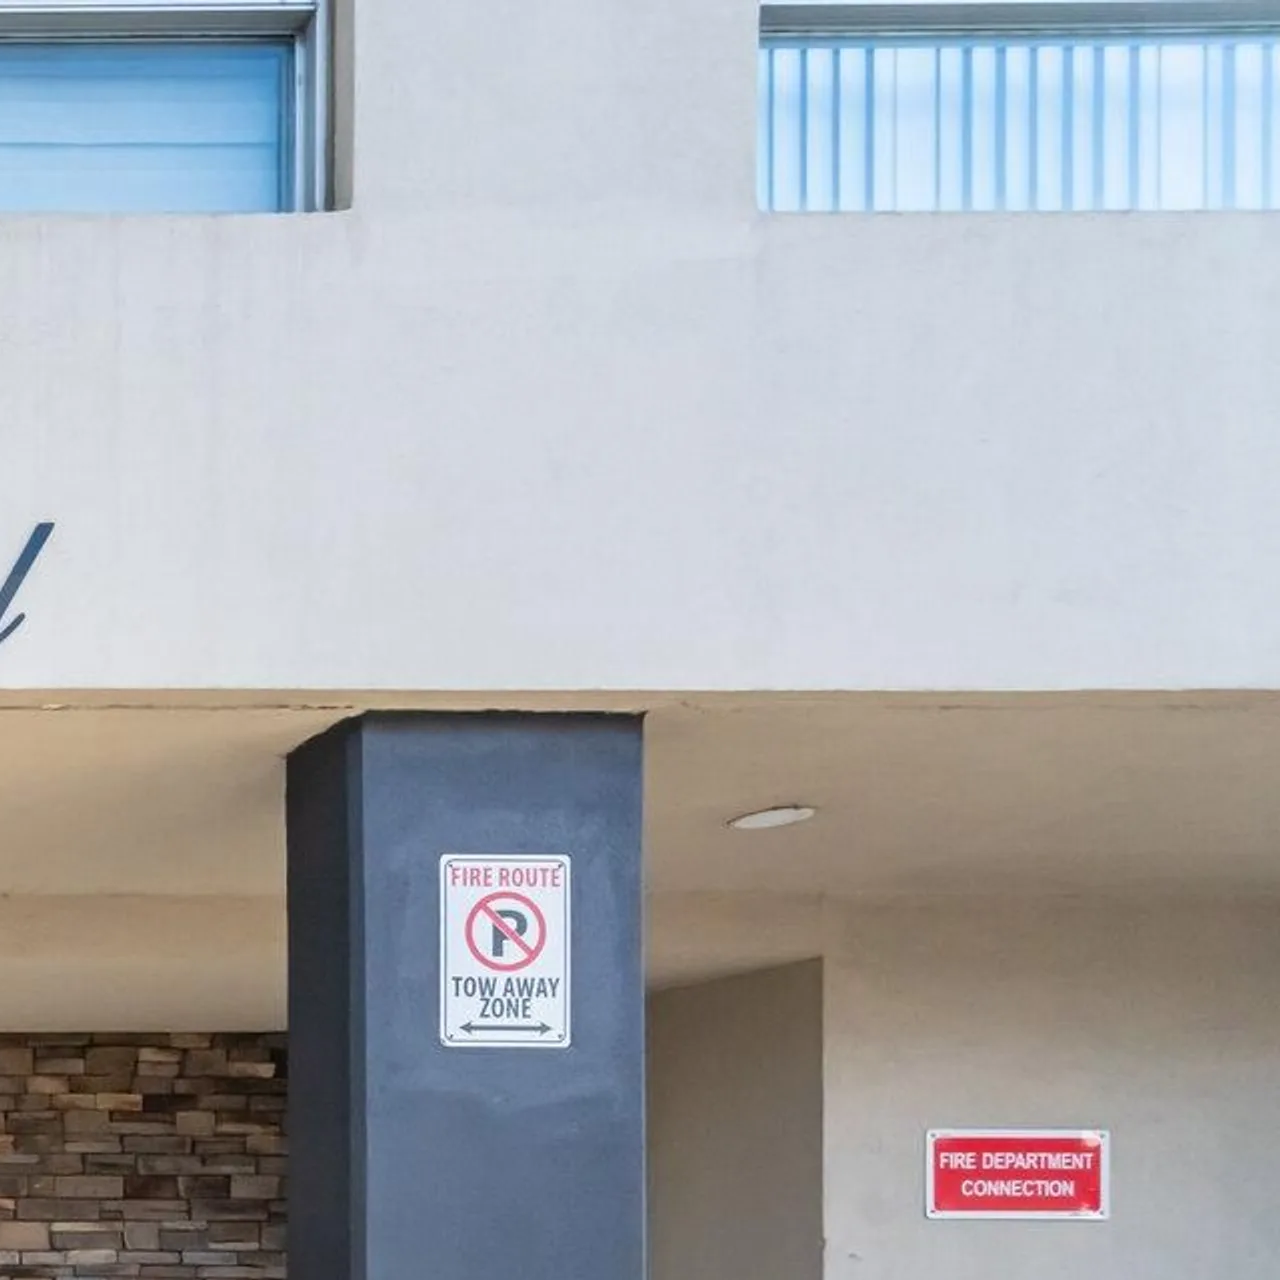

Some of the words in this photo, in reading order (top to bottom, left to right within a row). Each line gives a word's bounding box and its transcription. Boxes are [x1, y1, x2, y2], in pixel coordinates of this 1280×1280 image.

[451, 867, 493, 887] FIRE
[498, 867, 561, 888] ROUTE
[452, 976, 498, 997] TOW
[501, 977, 561, 998] AWAY
[478, 998, 532, 1019] ZONE
[939, 1151, 977, 1170] FIRE
[981, 1151, 1094, 1170] DEPARTMENT
[960, 1179, 1075, 1197] CONNECTION
